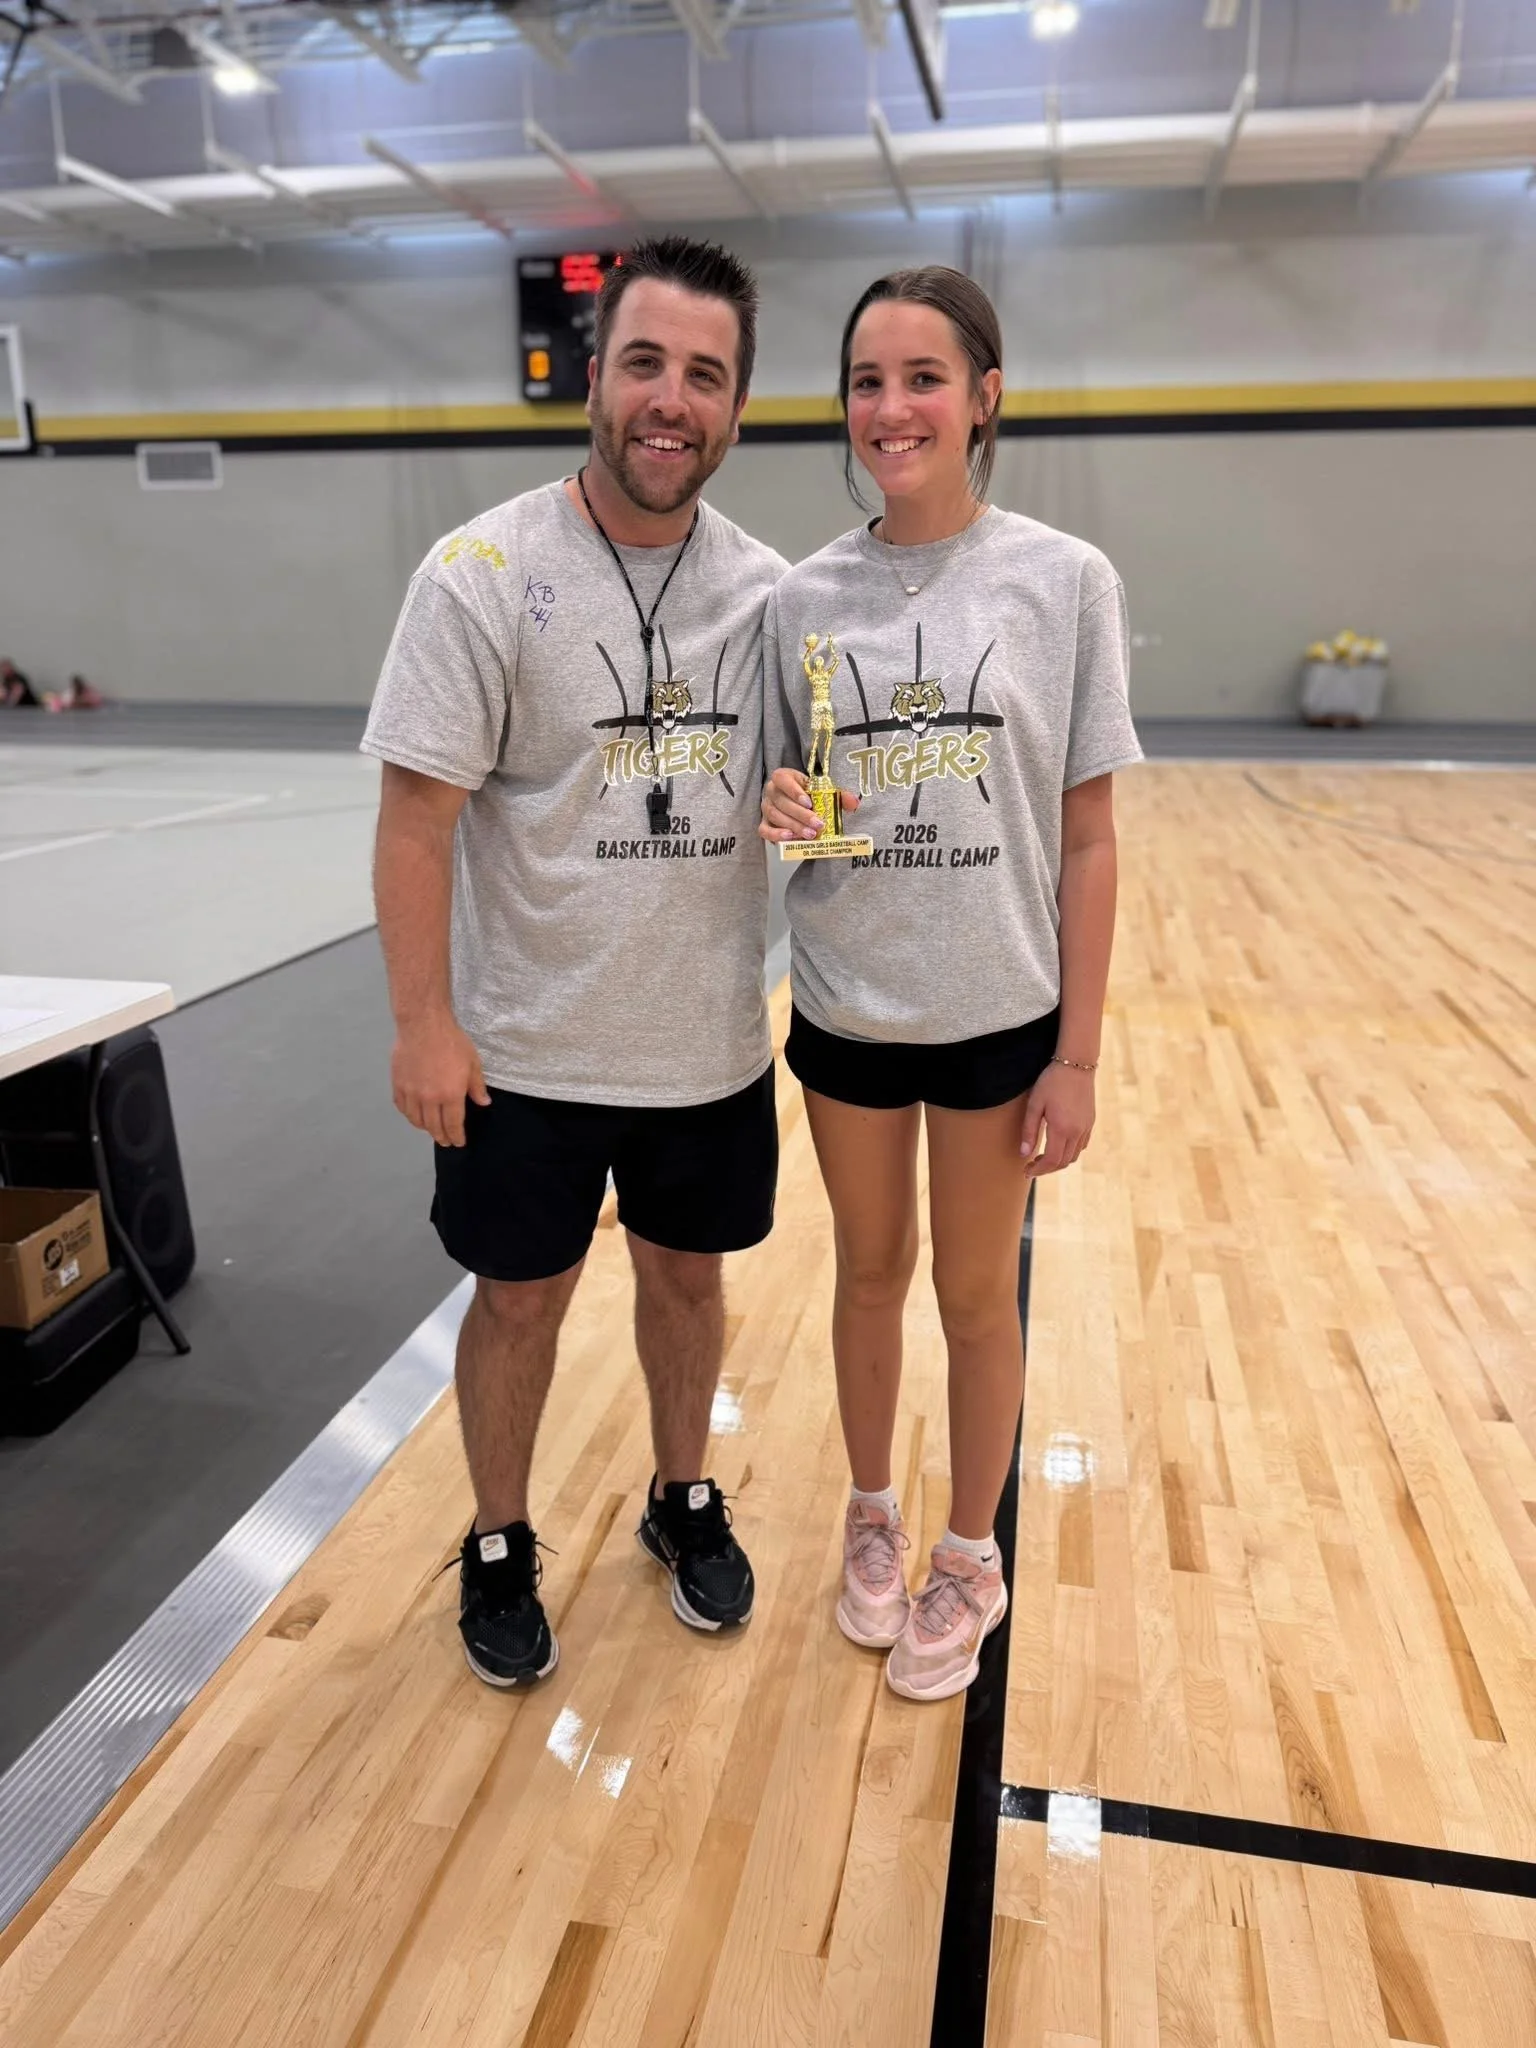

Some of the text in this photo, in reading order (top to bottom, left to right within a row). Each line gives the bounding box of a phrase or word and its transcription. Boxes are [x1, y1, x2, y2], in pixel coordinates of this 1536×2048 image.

[524, 575, 556, 604] KB
[600, 728, 732, 787] TIGERS
[846, 730, 992, 797] TIGERS
[857, 839, 869, 847] CAMP
[893, 824, 938, 844] 2026
[596, 836, 737, 860] BASKETBALL CAMP
[951, 846, 1000, 868] CAMP
